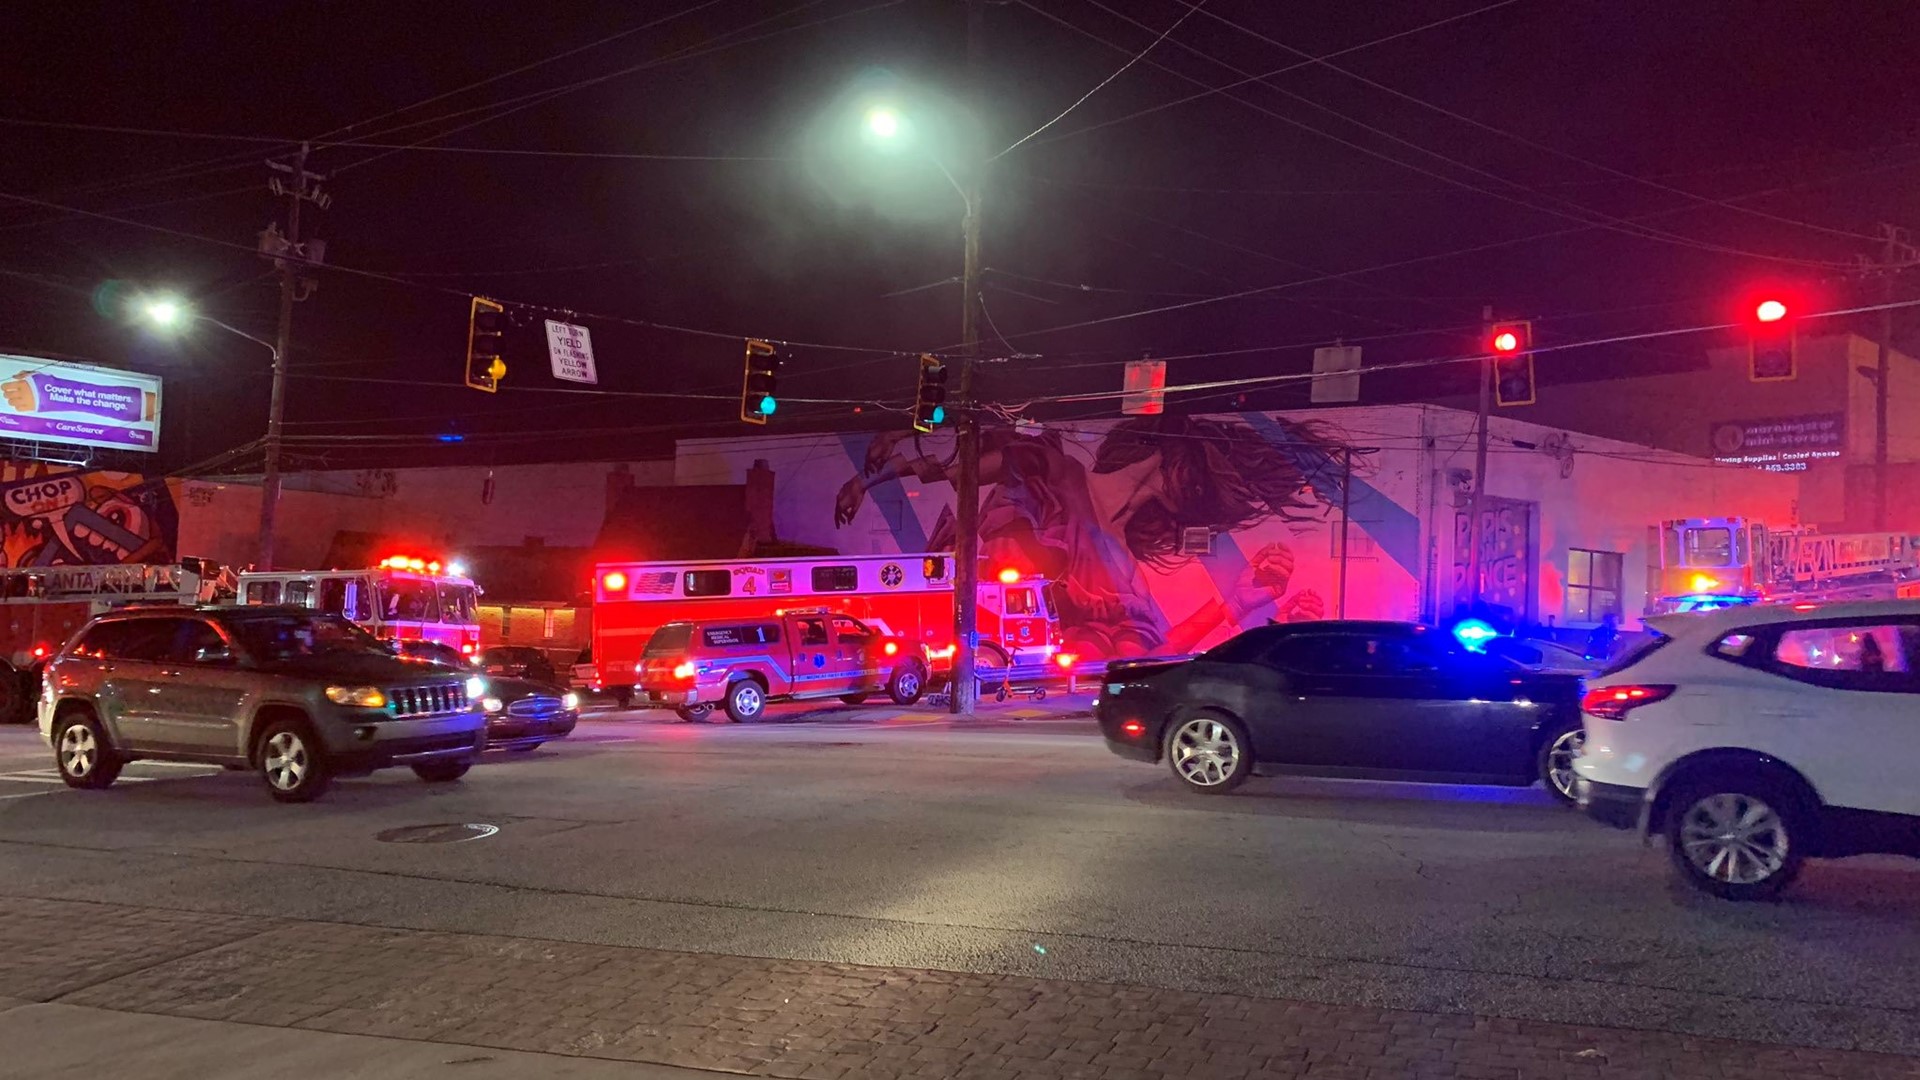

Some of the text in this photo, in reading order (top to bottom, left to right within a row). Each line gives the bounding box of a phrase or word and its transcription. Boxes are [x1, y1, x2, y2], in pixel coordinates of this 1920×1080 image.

[552, 325, 566, 334] LEFT
[557, 336, 582, 349] YIELD
[559, 358, 587, 369] YELLOW
[562, 368, 587, 378] ARROW
[44, 383, 134, 404] Cover what matters.
[49, 392, 128, 411] Make the change.
[56, 422, 104, 435] CareSource
[11, 481, 72, 505] CHOP
[742, 576, 756, 595] 4
[756, 627, 766, 642] 1
